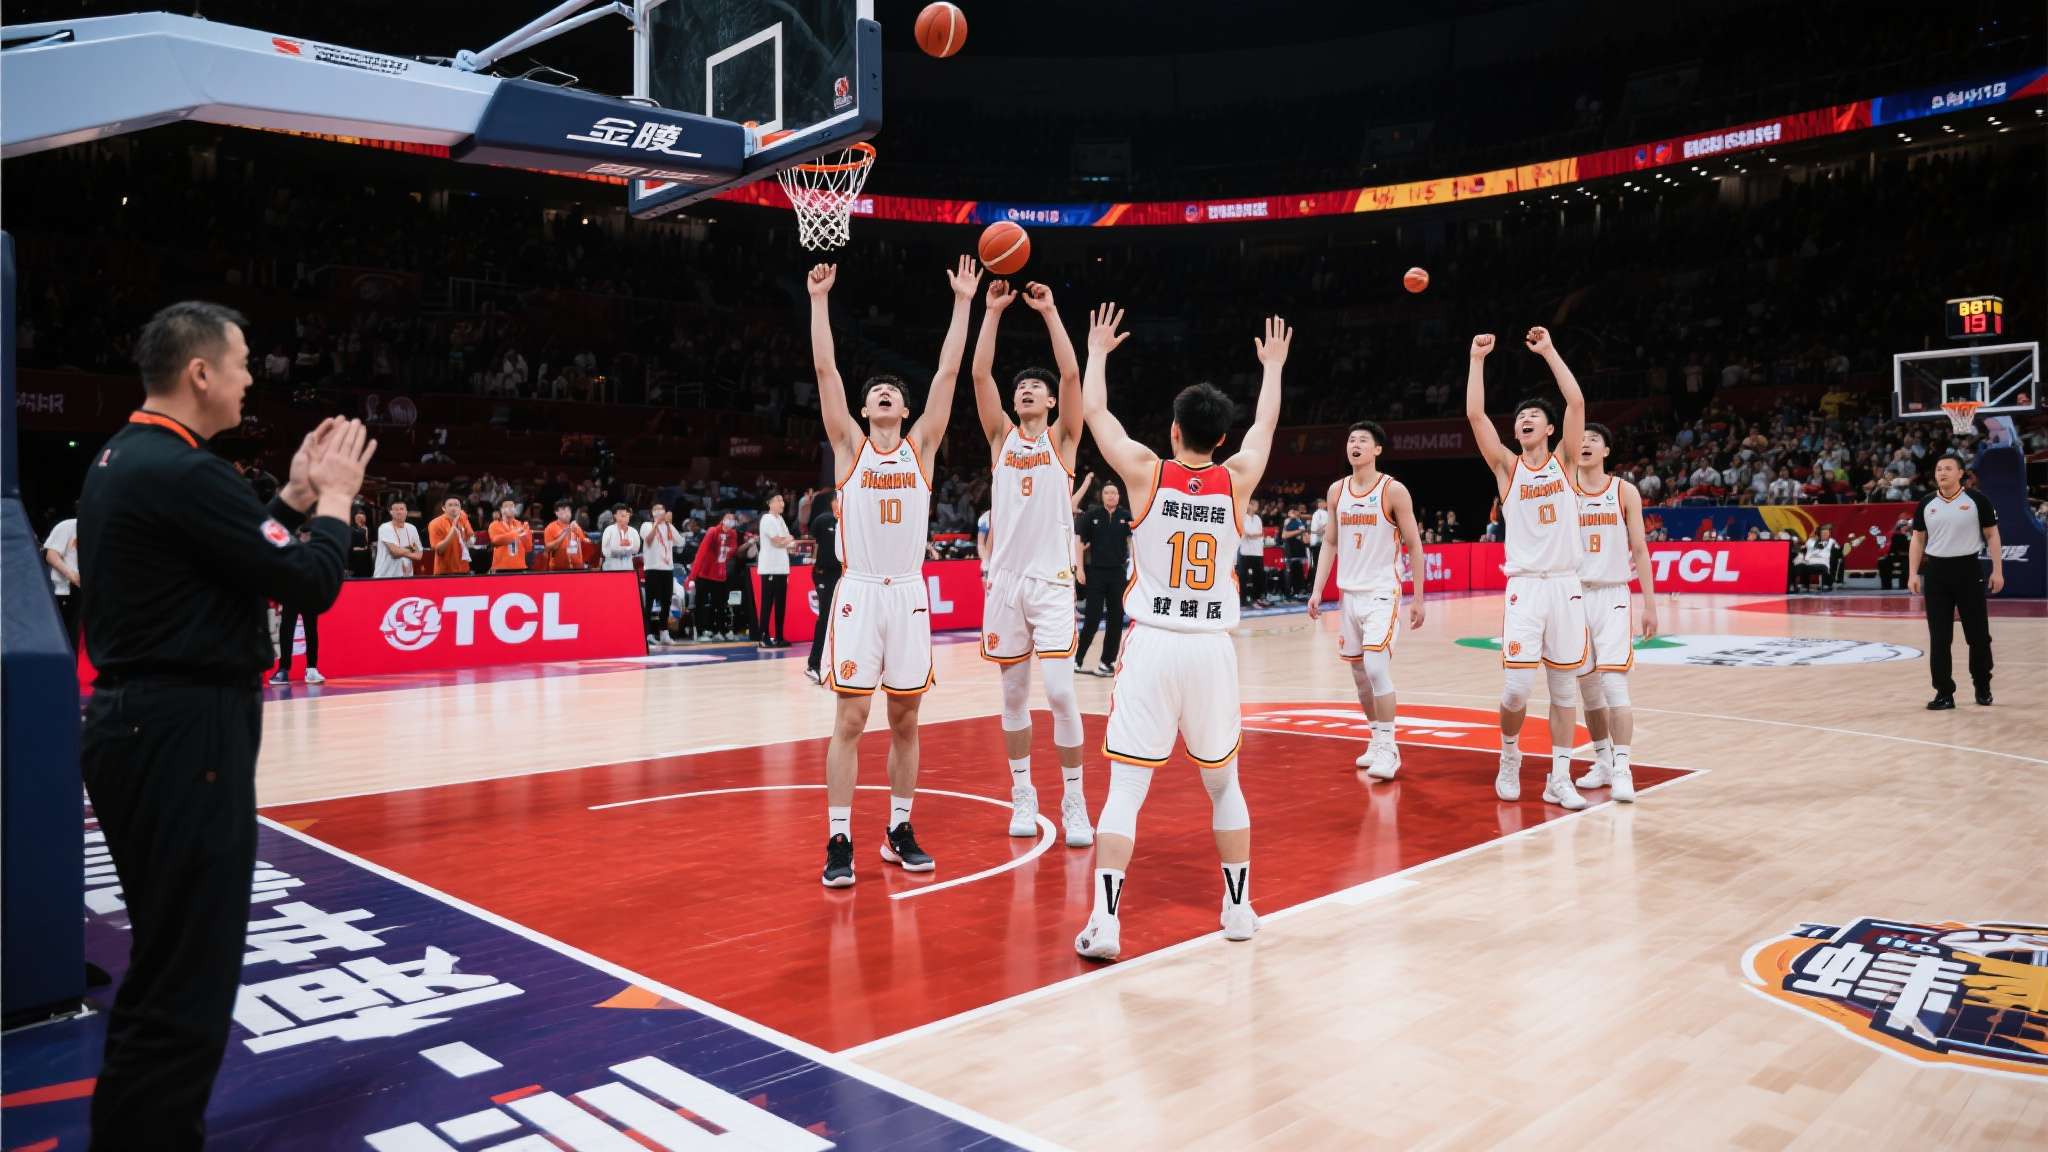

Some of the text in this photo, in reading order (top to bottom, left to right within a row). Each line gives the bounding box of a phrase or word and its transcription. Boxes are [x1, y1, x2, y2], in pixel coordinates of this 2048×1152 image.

[879, 498, 902, 524] 10
[1166, 530, 1218, 591] 19
[1650, 549, 1740, 582] TCL
[442, 592, 579, 646] TCL
